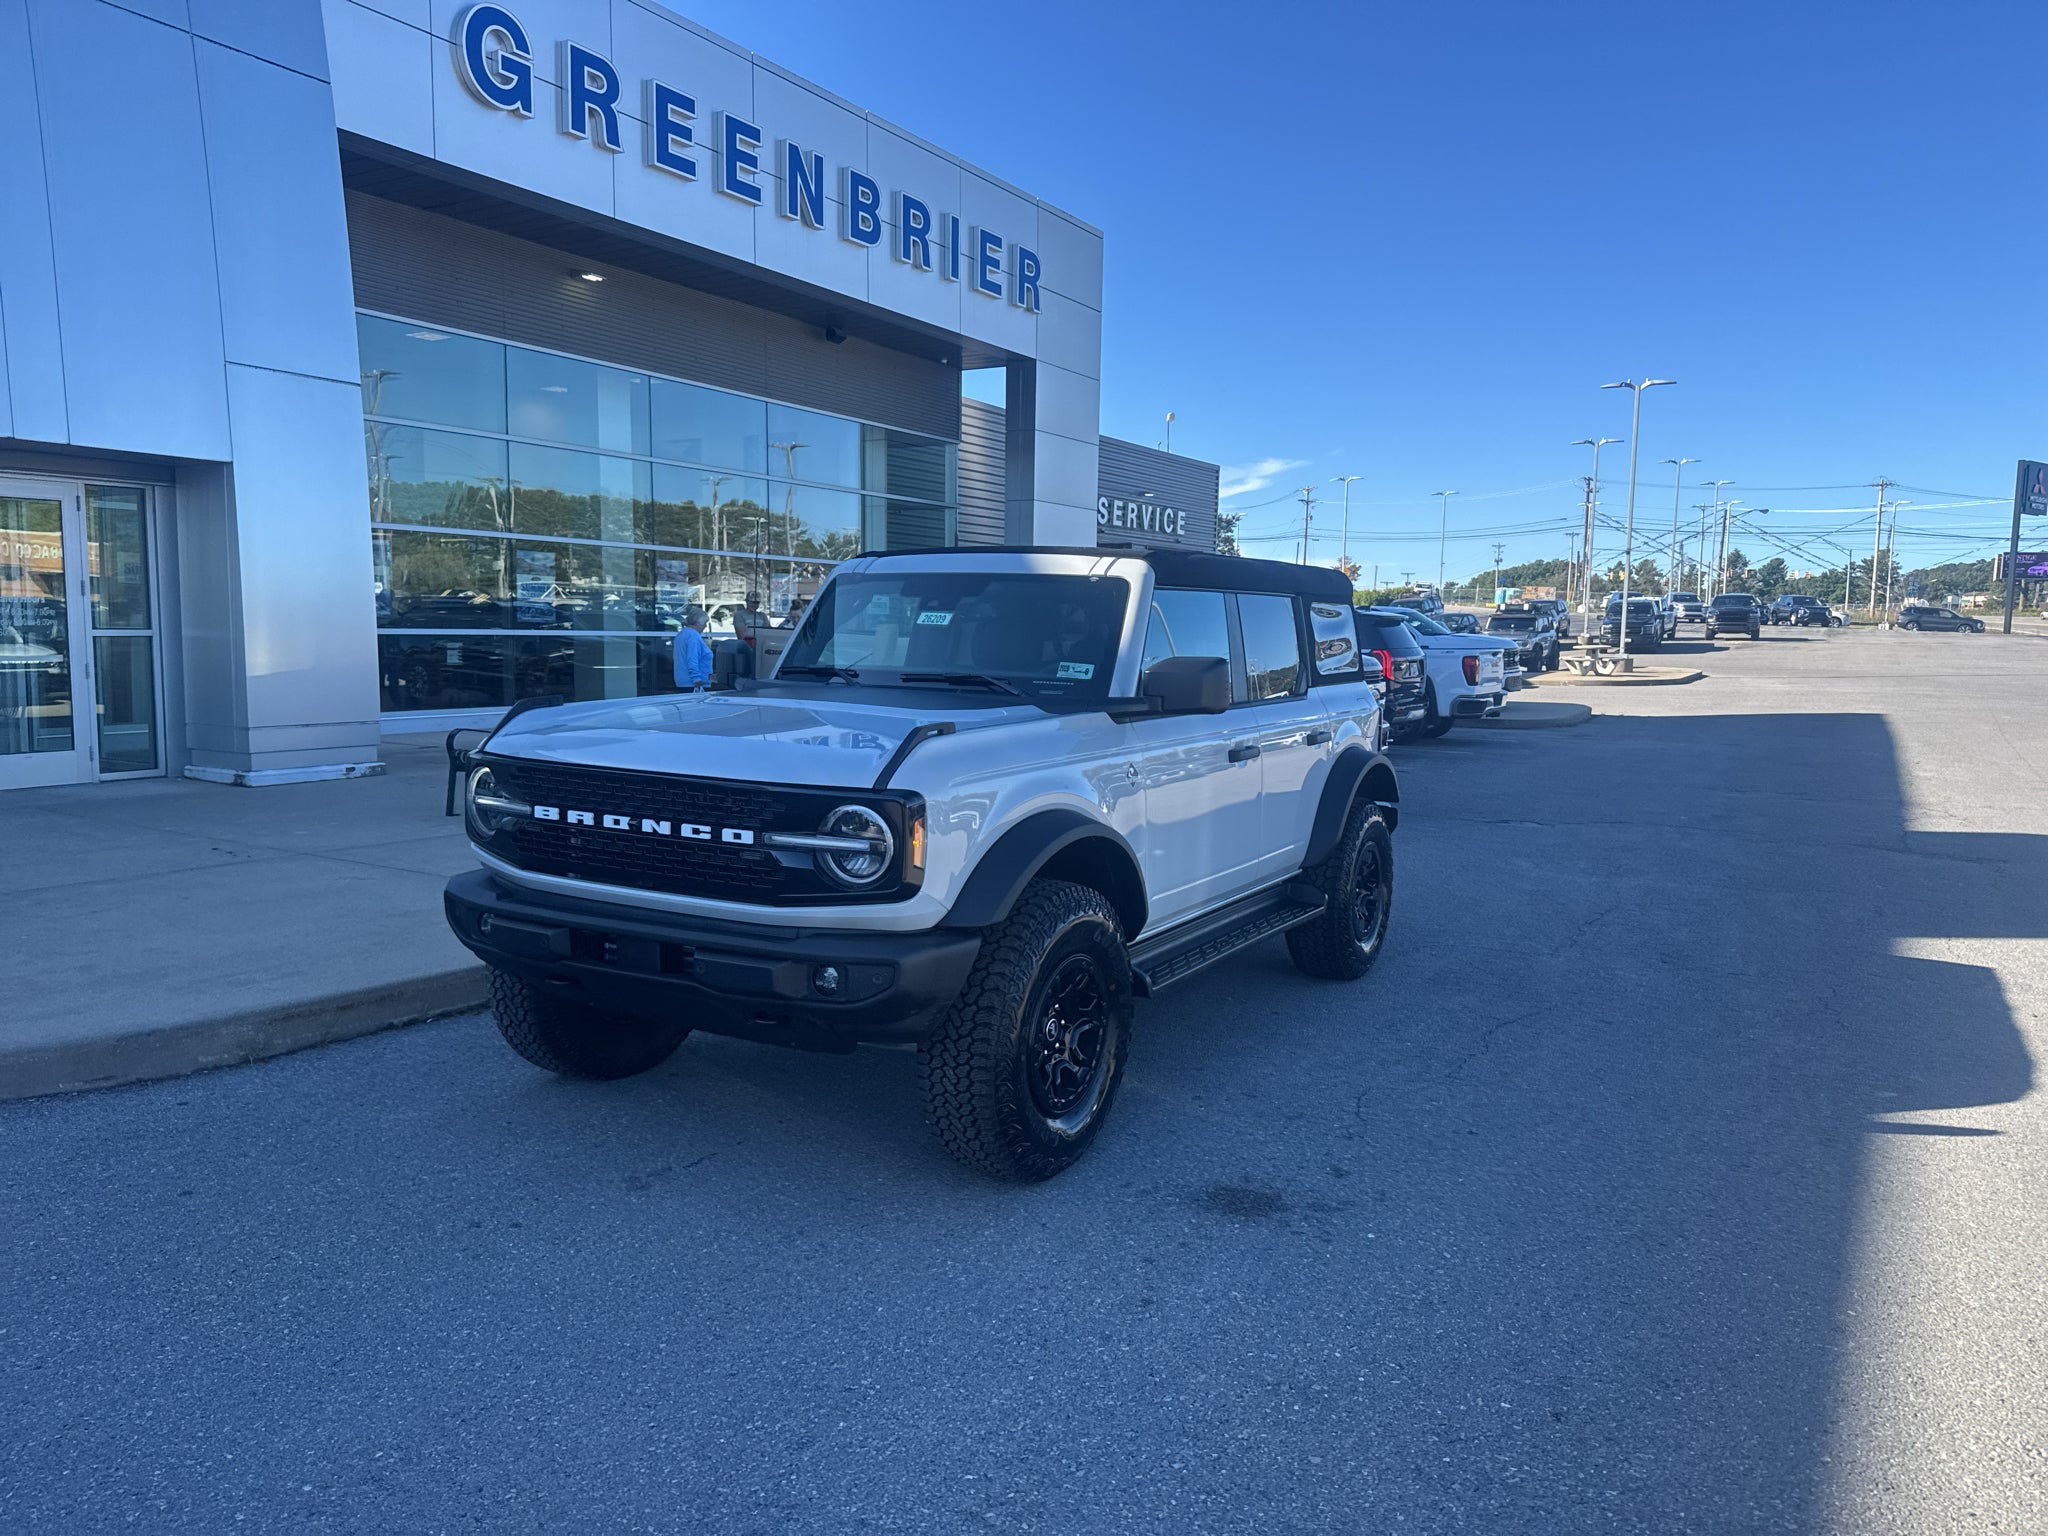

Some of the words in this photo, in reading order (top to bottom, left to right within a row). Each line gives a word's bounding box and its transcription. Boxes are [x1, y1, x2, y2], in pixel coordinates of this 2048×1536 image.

[454, 2, 1043, 314] GREENBRIER
[1098, 497, 1186, 535] SERVICE
[921, 613, 947, 624] 26209
[534, 804, 754, 844] BRONCO
